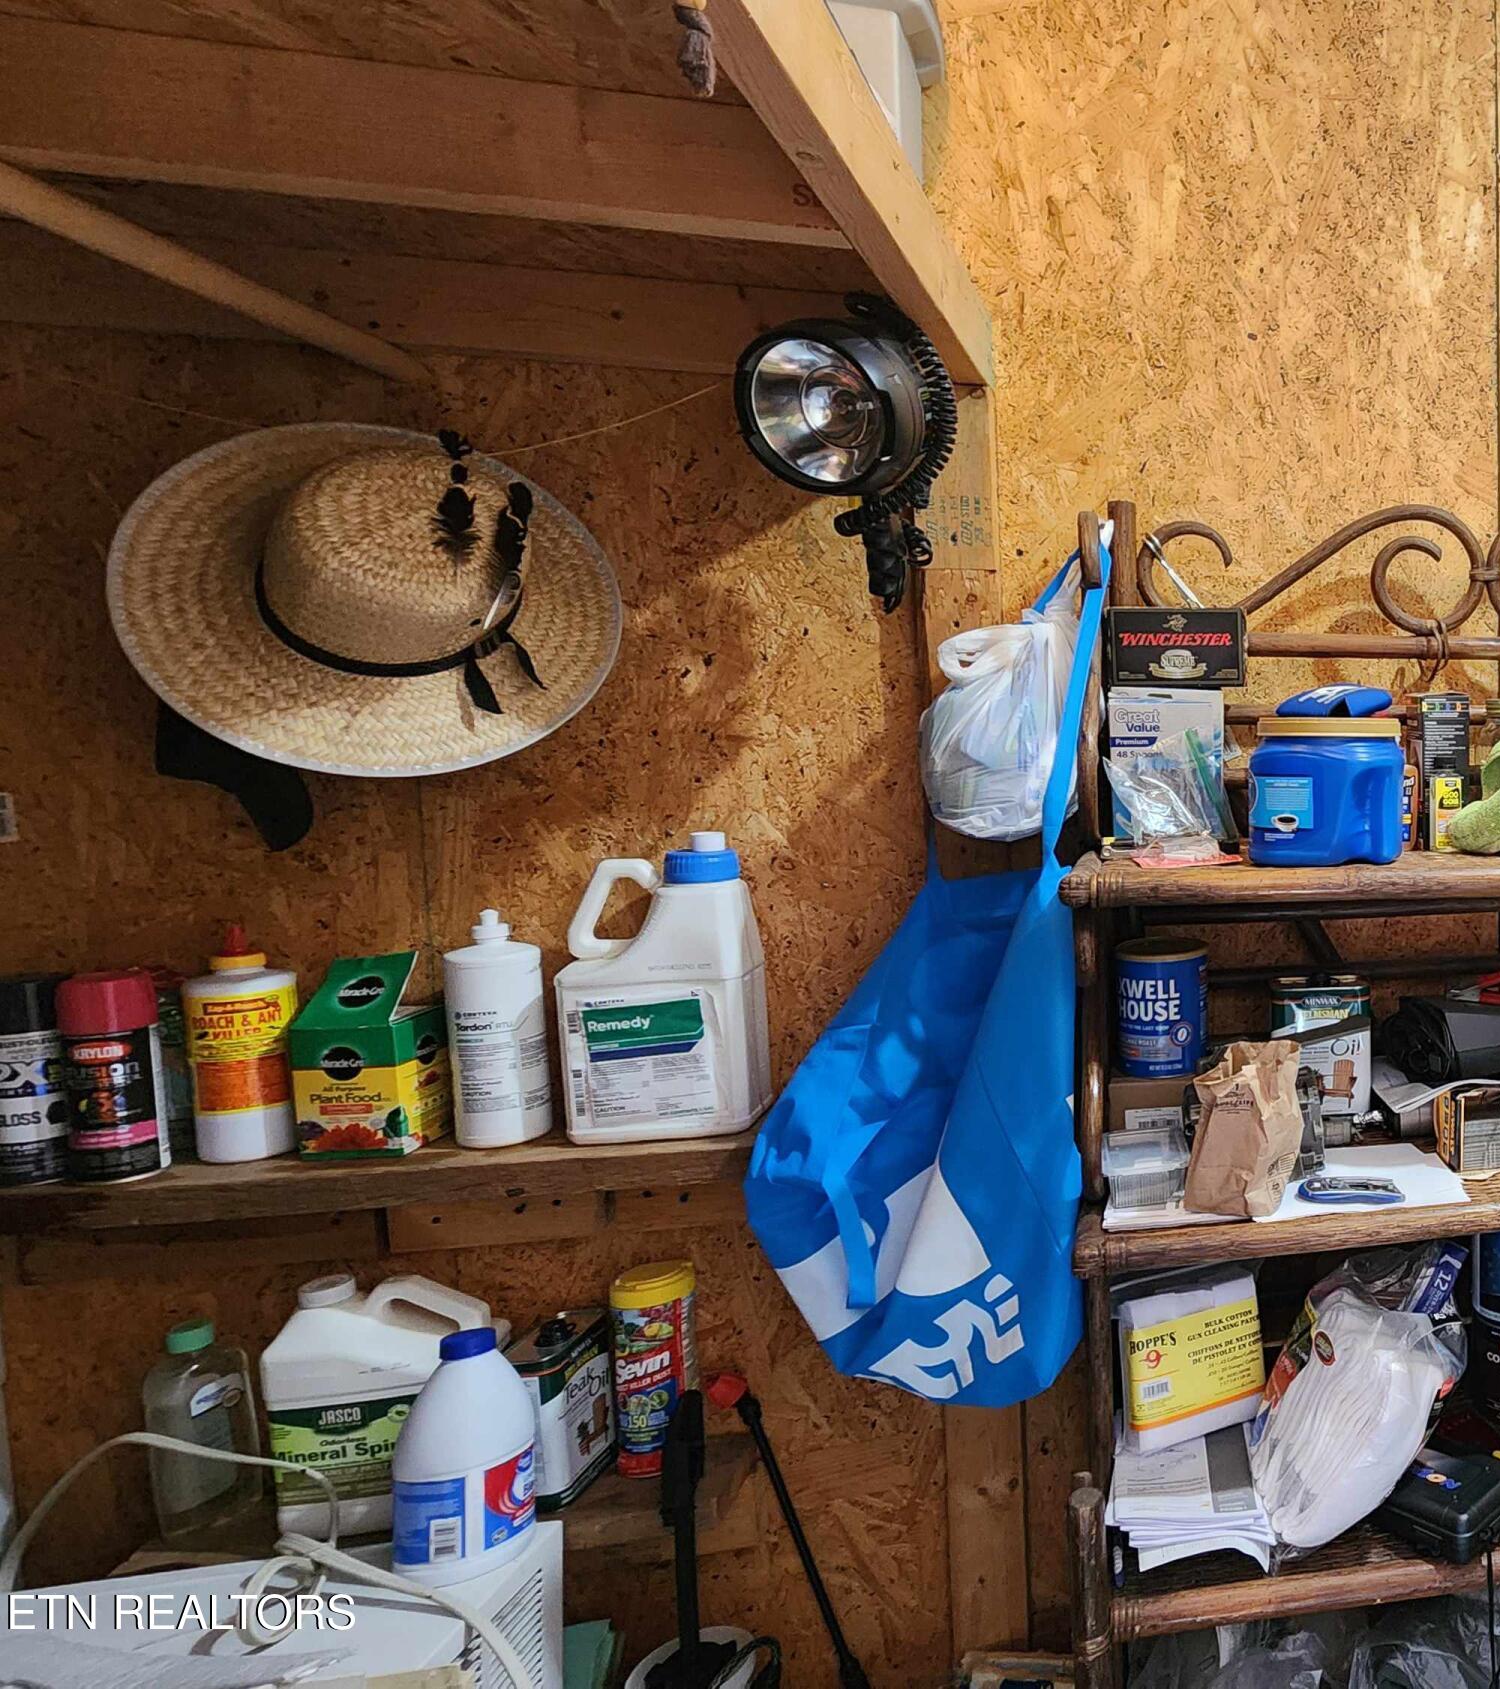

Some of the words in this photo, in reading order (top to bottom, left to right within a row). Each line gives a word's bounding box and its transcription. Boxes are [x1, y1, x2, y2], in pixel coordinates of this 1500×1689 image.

[1119, 632, 1233, 647] WINCHESTER
[1115, 708, 1160, 724] Great
[1126, 723, 1160, 733] Value
[1115, 738, 1149, 746] Premium
[1120, 1000, 1181, 1022] HOUSE
[1304, 998, 1338, 1006] MINWAX
[191, 1016, 235, 1030] ROACH
[241, 1014, 252, 1027] &
[258, 1010, 282, 1023] ANT
[587, 1016, 651, 1033] Remedy
[73, 1045, 124, 1060] KRYLON
[1330, 1038, 1361, 1057] Oil
[310, 1093, 344, 1104] Plant
[345, 1092, 382, 1103] Food
[1433, 1269, 1453, 1292] 12
[1204, 1318, 1224, 1329] BULK
[1225, 1309, 1253, 1323] COTTON
[1187, 1333, 1202, 1342] GUN
[1204, 1321, 1239, 1337] CLEANING
[1129, 1331, 1178, 1356] HOPPE'S
[1187, 1342, 1224, 1358] CHIFFONS
[1225, 1338, 1234, 1346] DE
[1192, 1357, 1203, 1365] DE
[1204, 1346, 1237, 1362] PISTOLET
[1238, 1343, 1247, 1351] EN
[616, 1351, 671, 1384] Sevin
[564, 1367, 594, 1403] Teak
[589, 1368, 609, 1396] Oil
[318, 1407, 361, 1425] JASCO
[629, 1415, 647, 1428] 150
[319, 1436, 367, 1447] Odorless
